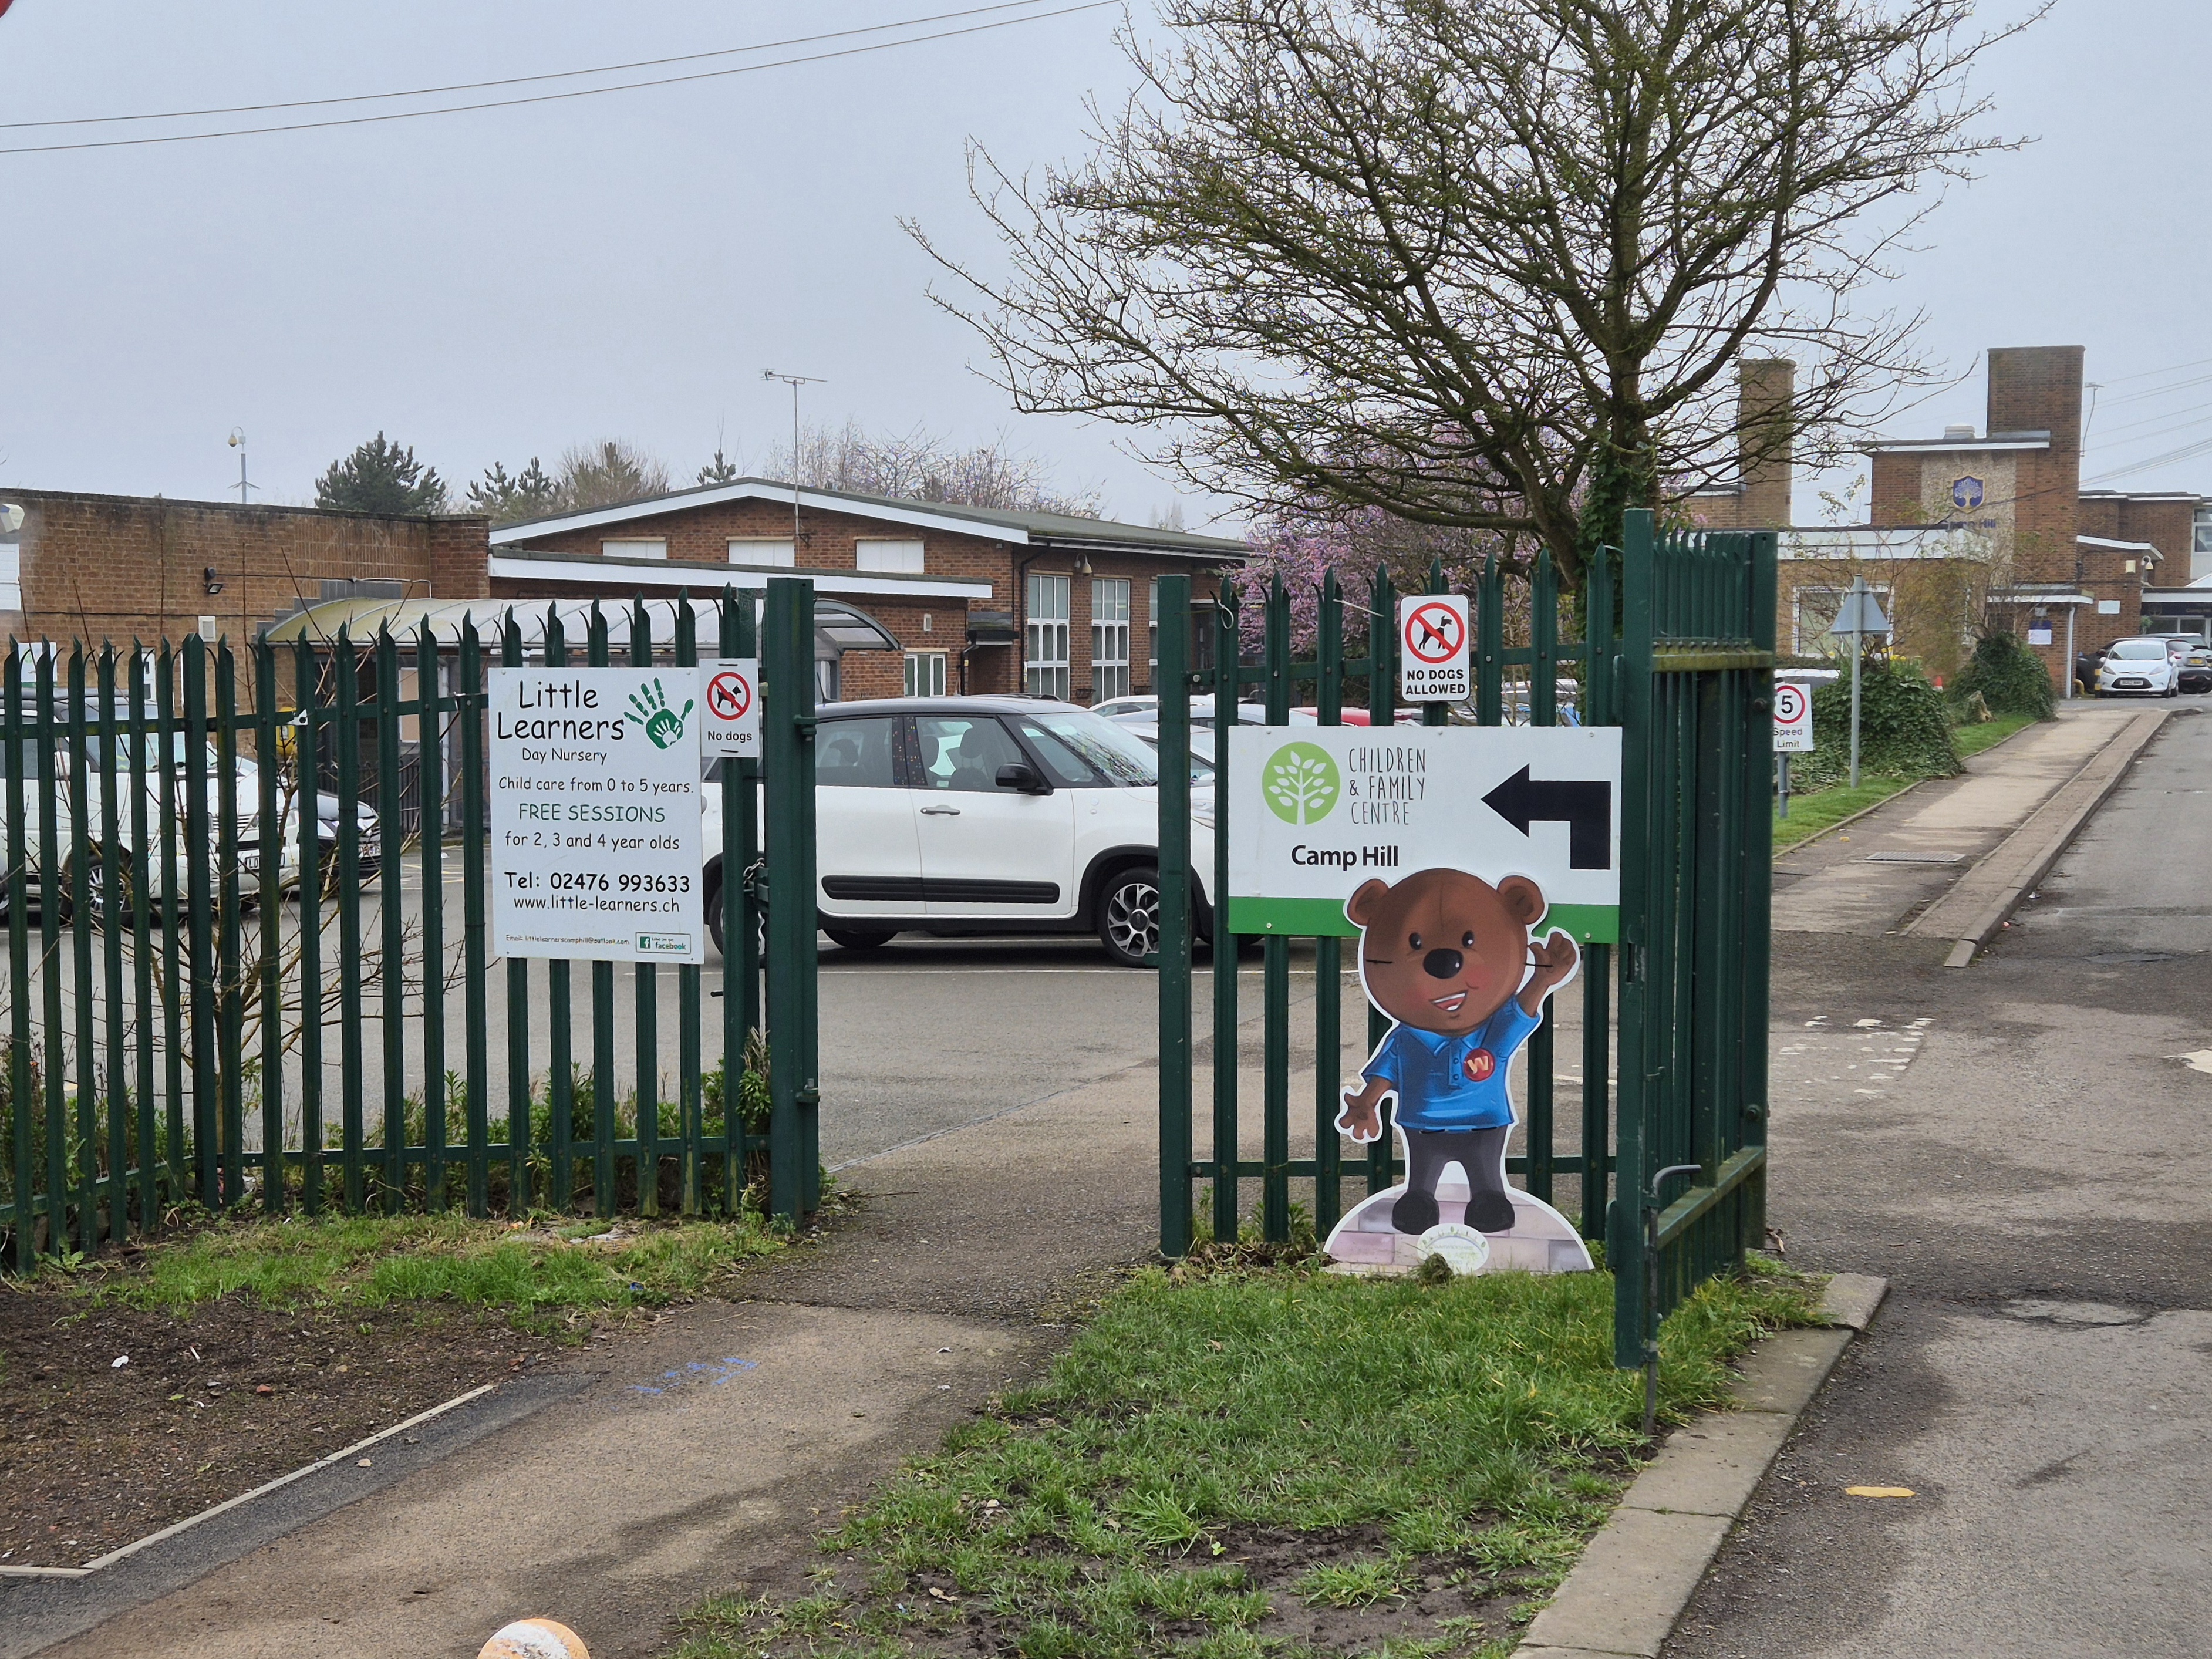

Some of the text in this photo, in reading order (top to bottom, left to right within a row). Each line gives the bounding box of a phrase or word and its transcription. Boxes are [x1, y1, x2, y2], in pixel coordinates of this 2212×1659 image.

[1407, 669, 1464, 680] NO DOGS
[520, 680, 599, 709] Little
[1405, 684, 1465, 694] ALLOWED
[1781, 695, 1793, 714] 5
[498, 712, 624, 740] Learners
[1773, 727, 1803, 737] Speed
[708, 731, 752, 743] No dogs
[522, 747, 607, 765] Day Nursery
[1349, 746, 1425, 773] CHILDREN
[499, 776, 693, 796] Child care from 0 to 5 years.
[1350, 774, 1425, 800] & FAMILY
[520, 803, 665, 822] FREE SESSIONS
[1351, 801, 1409, 825] CENTRE
[505, 831, 679, 852] for 2, 3 and 4 year olds
[1292, 845, 1398, 871] Camp Hill
[504, 871, 690, 892] Tel: 02476 993633
[514, 894, 680, 912] www.little-learners.ch
[656, 942, 686, 950] facebook
